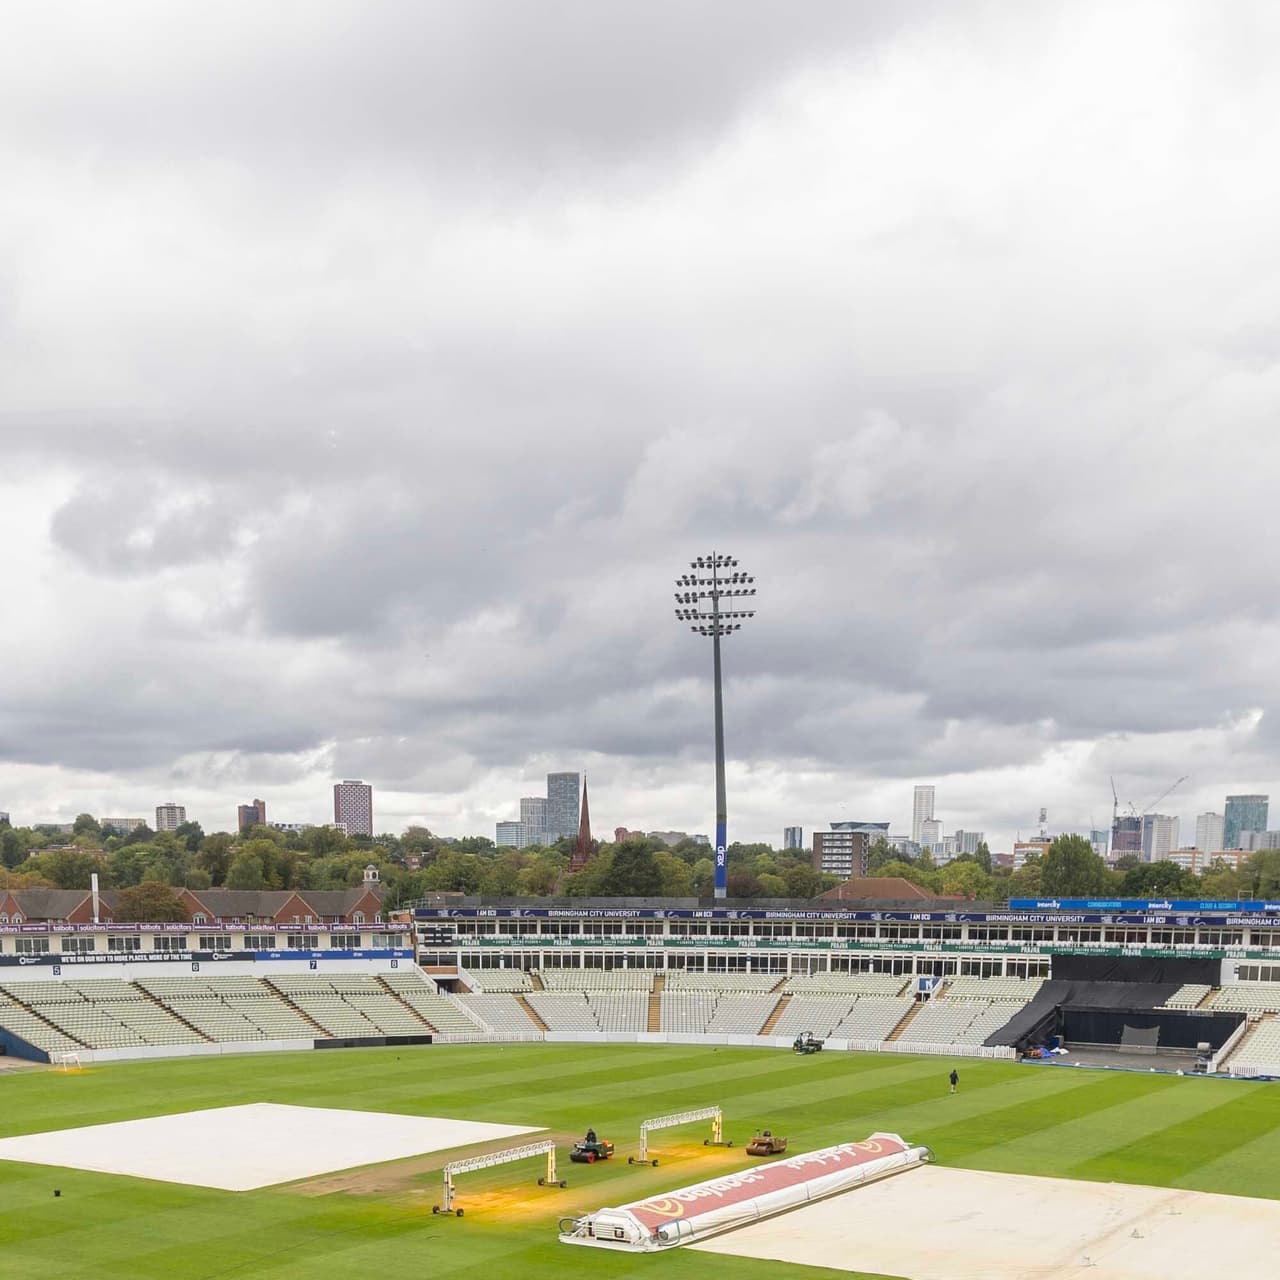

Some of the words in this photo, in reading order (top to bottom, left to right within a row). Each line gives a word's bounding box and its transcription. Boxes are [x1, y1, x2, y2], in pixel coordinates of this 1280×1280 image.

[717, 845, 726, 867] drax
[765, 911, 805, 919] BIRMINGHAM
[821, 912, 857, 920] UNIVERSITY
[1226, 918, 1272, 926] BIRMINGHAM
